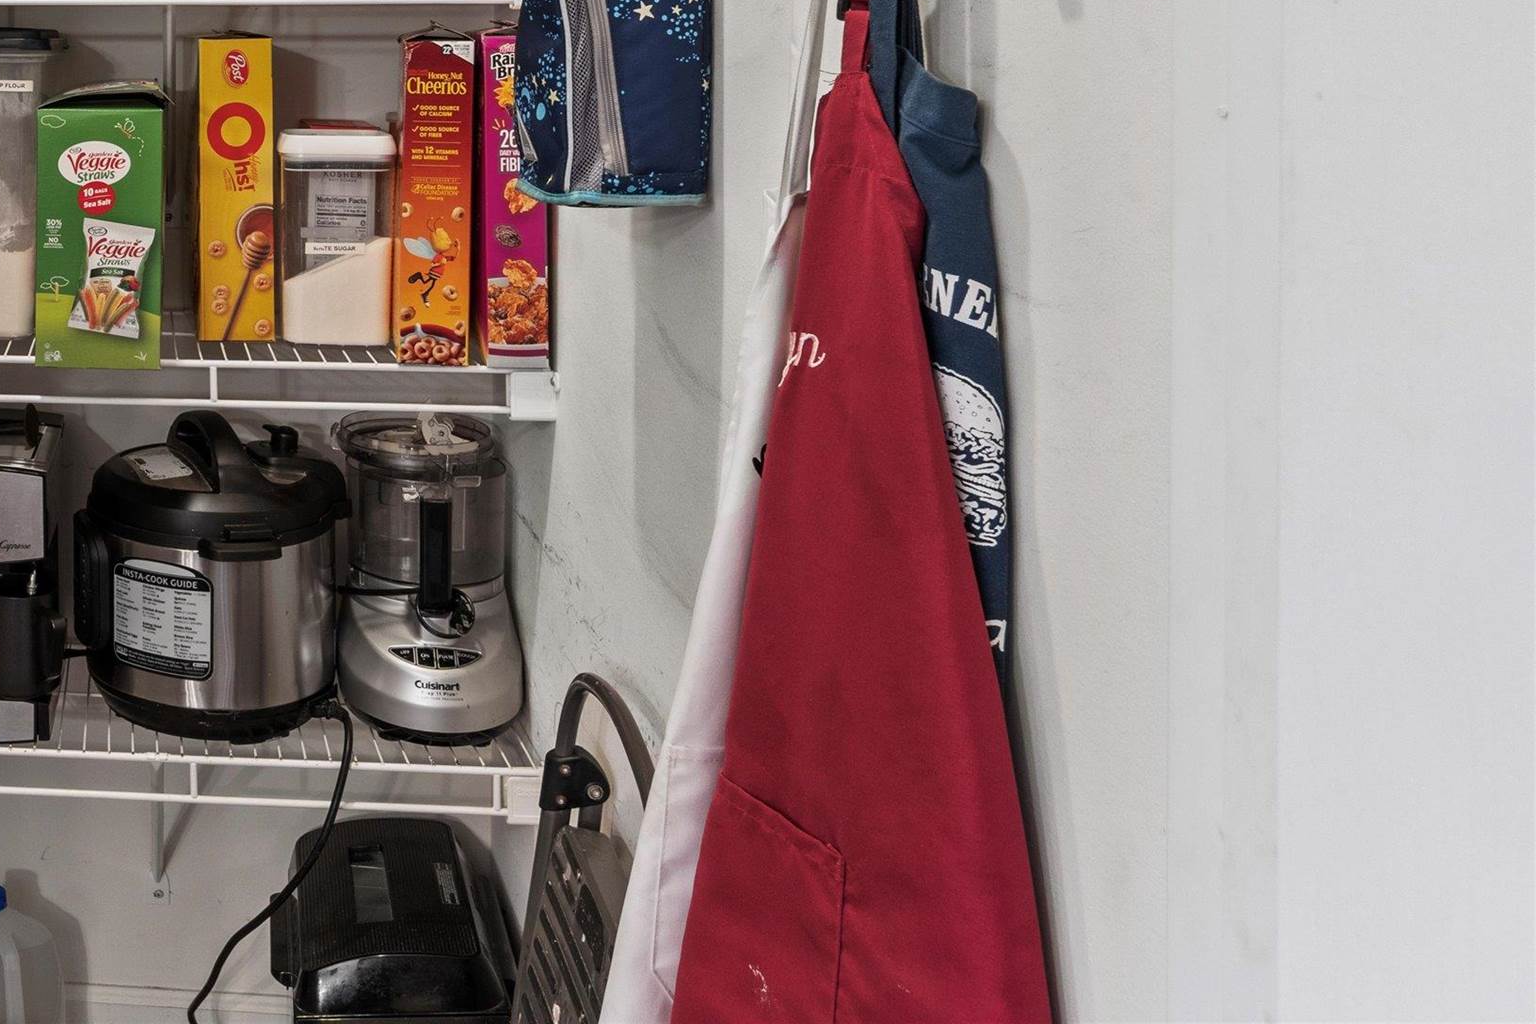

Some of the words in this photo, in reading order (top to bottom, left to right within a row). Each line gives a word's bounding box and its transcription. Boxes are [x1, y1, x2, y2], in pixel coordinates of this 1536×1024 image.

[492, 54, 515, 68] Rai
[228, 54, 247, 84] Post
[428, 72, 449, 81] Honey
[451, 72, 463, 80] Nut
[407, 77, 467, 95] Cheerios
[425, 146, 434, 154] 12
[67, 152, 126, 175] Veggie
[500, 158, 520, 172] FIB
[77, 170, 115, 184] Straws
[84, 188, 94, 196] 10
[97, 199, 111, 207] Salt
[88, 236, 145, 258] Veggie
[97, 258, 131, 267] Straws
[122, 568, 168, 585] INSTA-COOK
[170, 579, 198, 589] GUIDE
[415, 680, 460, 691] Cuisinart
